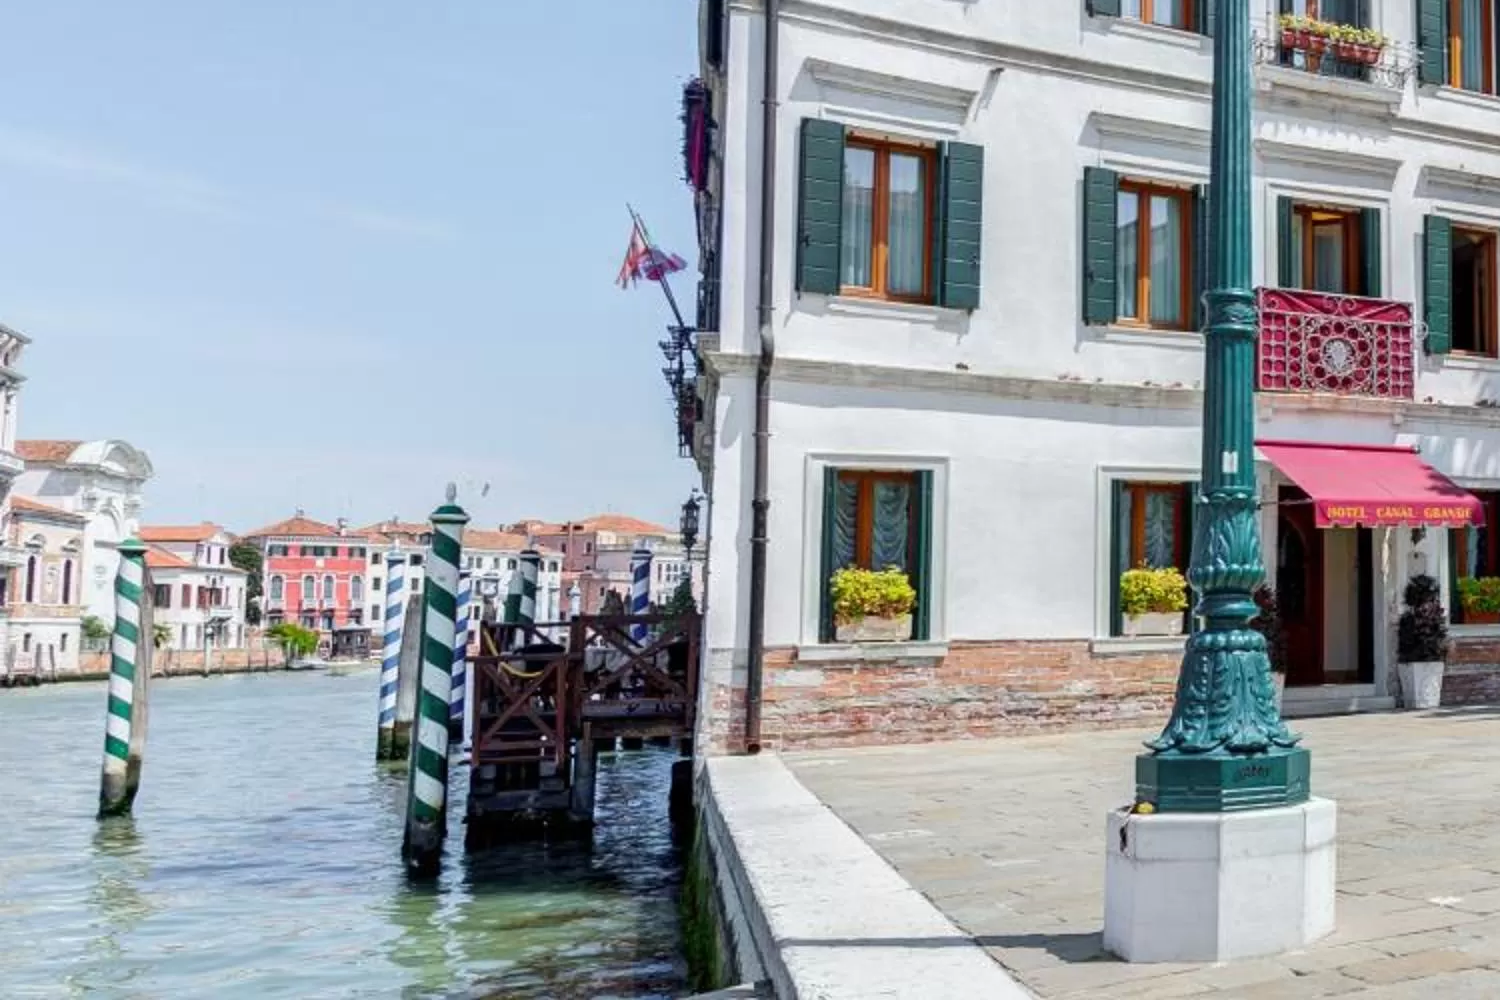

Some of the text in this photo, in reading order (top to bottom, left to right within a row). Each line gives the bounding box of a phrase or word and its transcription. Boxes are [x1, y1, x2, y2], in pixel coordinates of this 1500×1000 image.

[1327, 506, 1472, 519] HOTEL CANAL GRANDE
